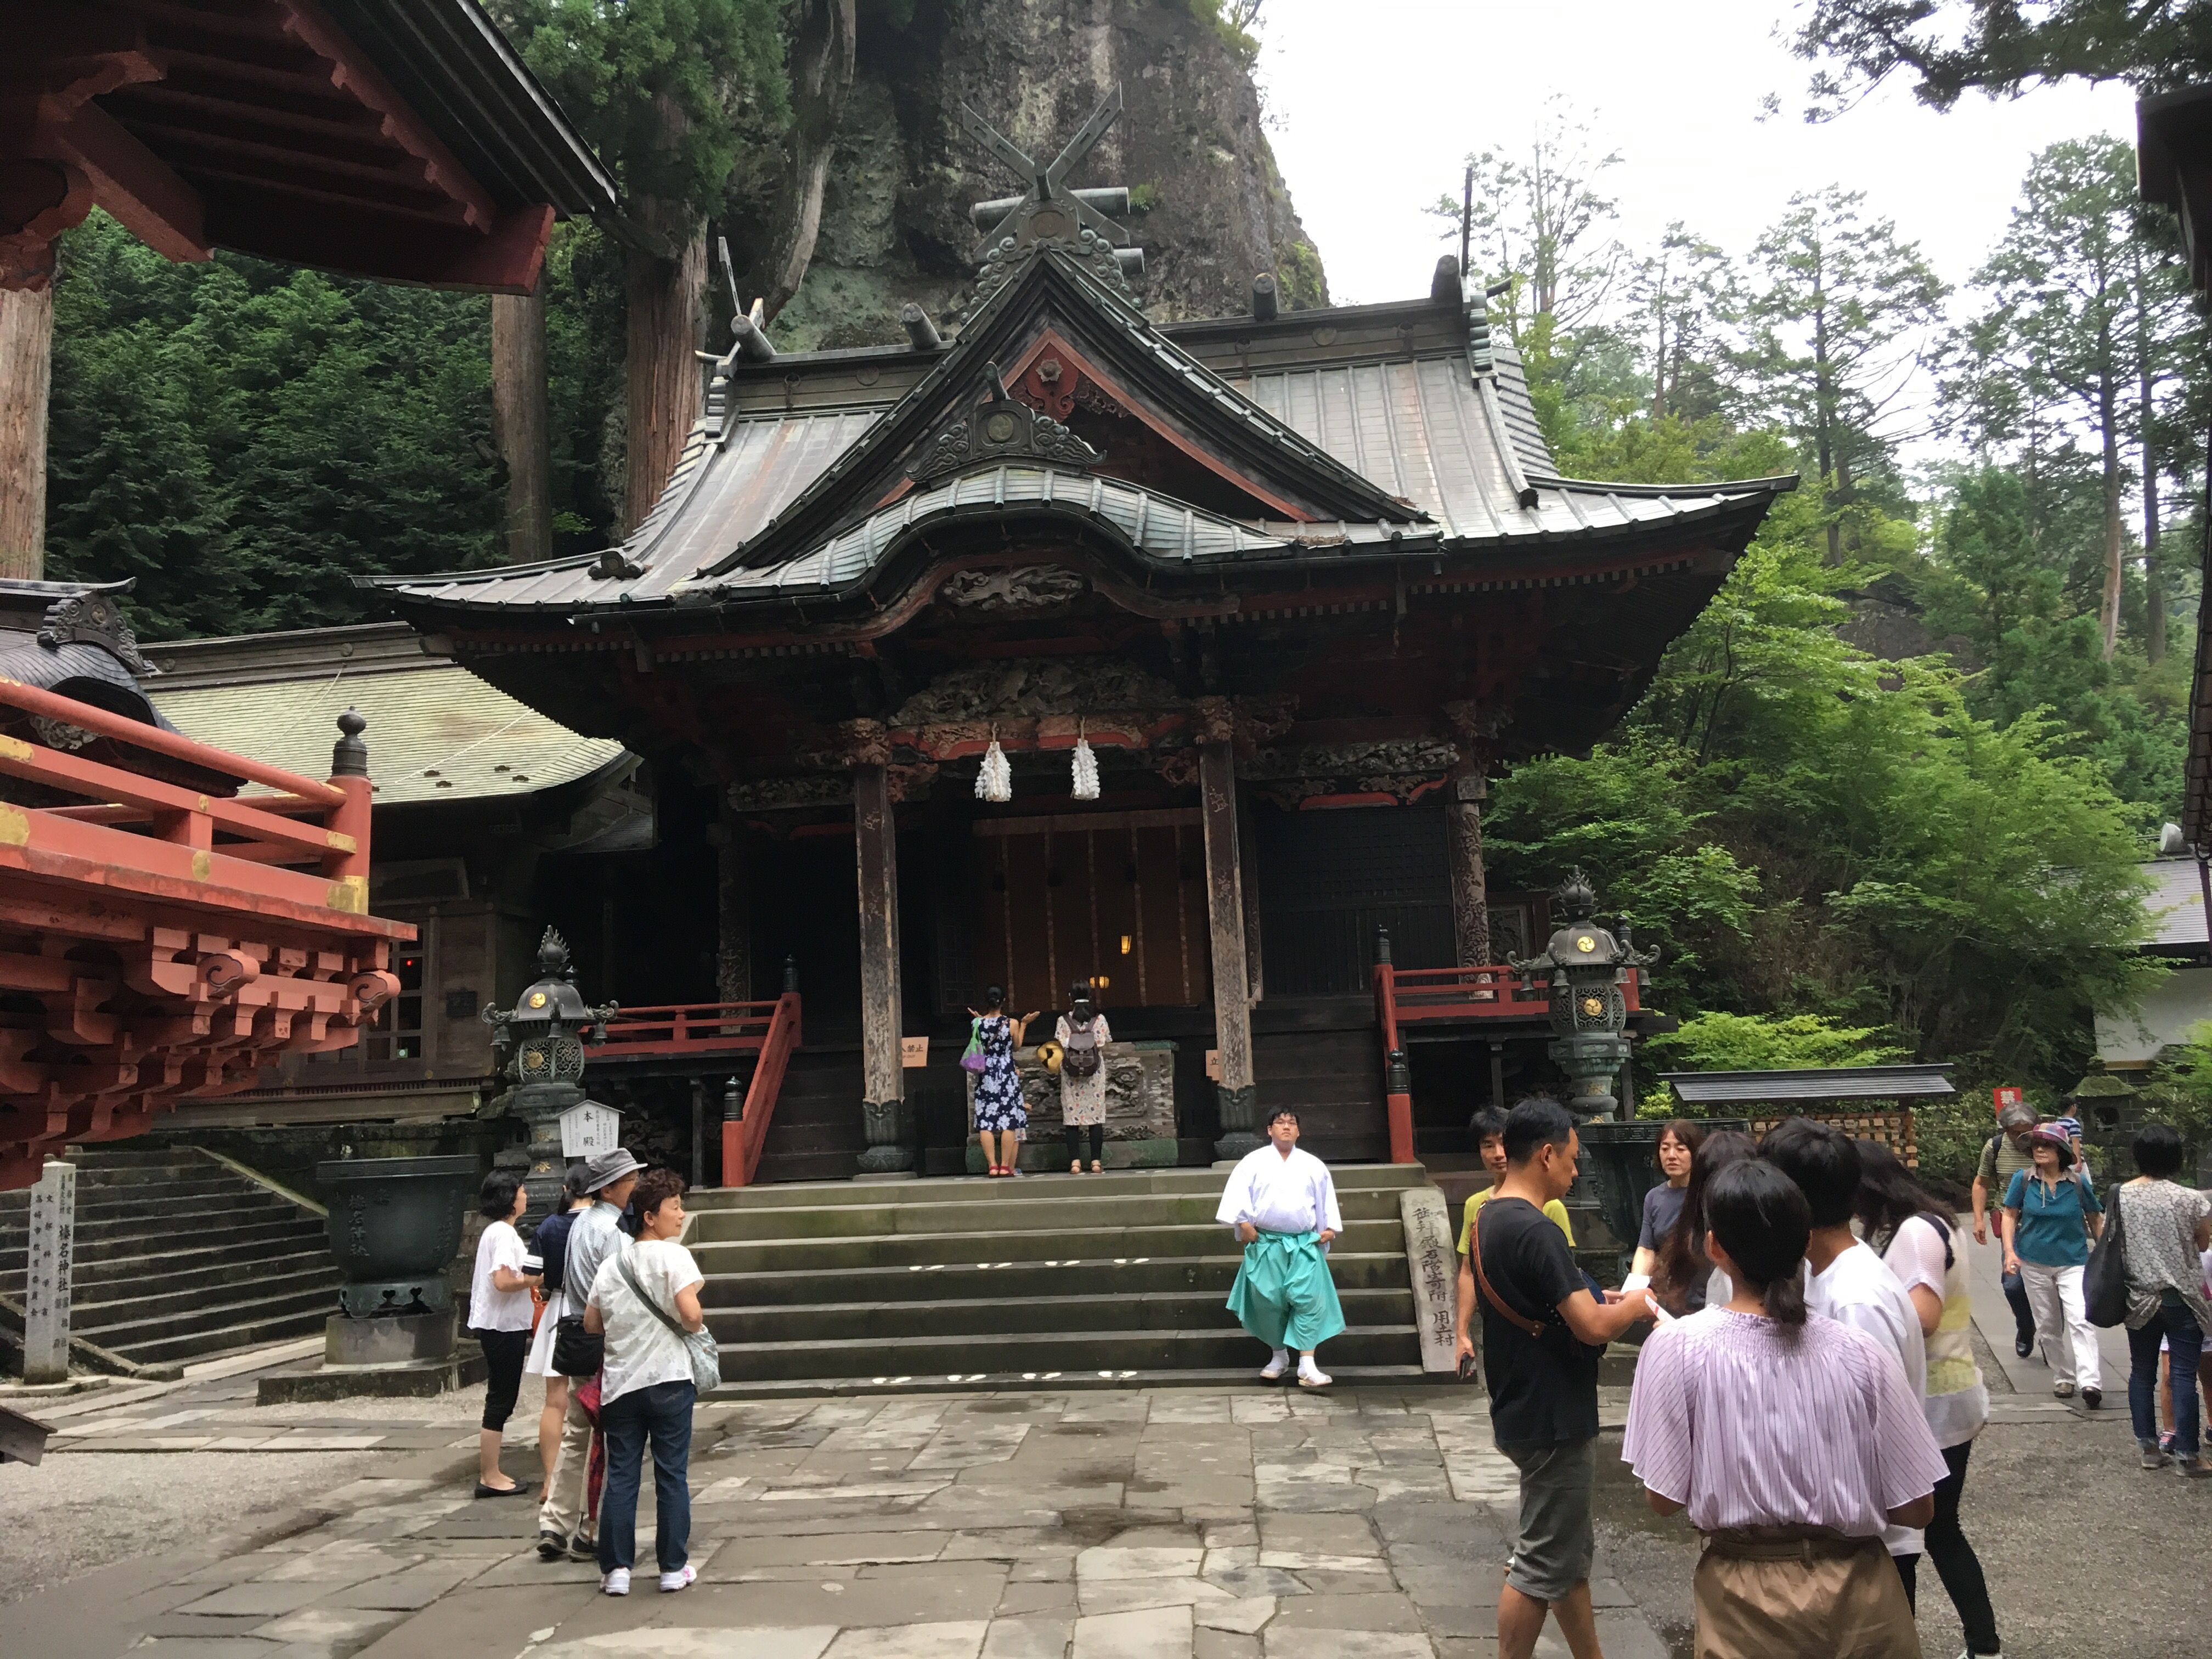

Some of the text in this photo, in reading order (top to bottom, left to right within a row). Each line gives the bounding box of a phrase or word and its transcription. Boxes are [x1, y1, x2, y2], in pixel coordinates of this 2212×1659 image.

[583, 1110, 595, 1147] 本殿
[57, 1224, 71, 1291] 榛名神社
[1433, 1310, 1455, 1346] 用土村
